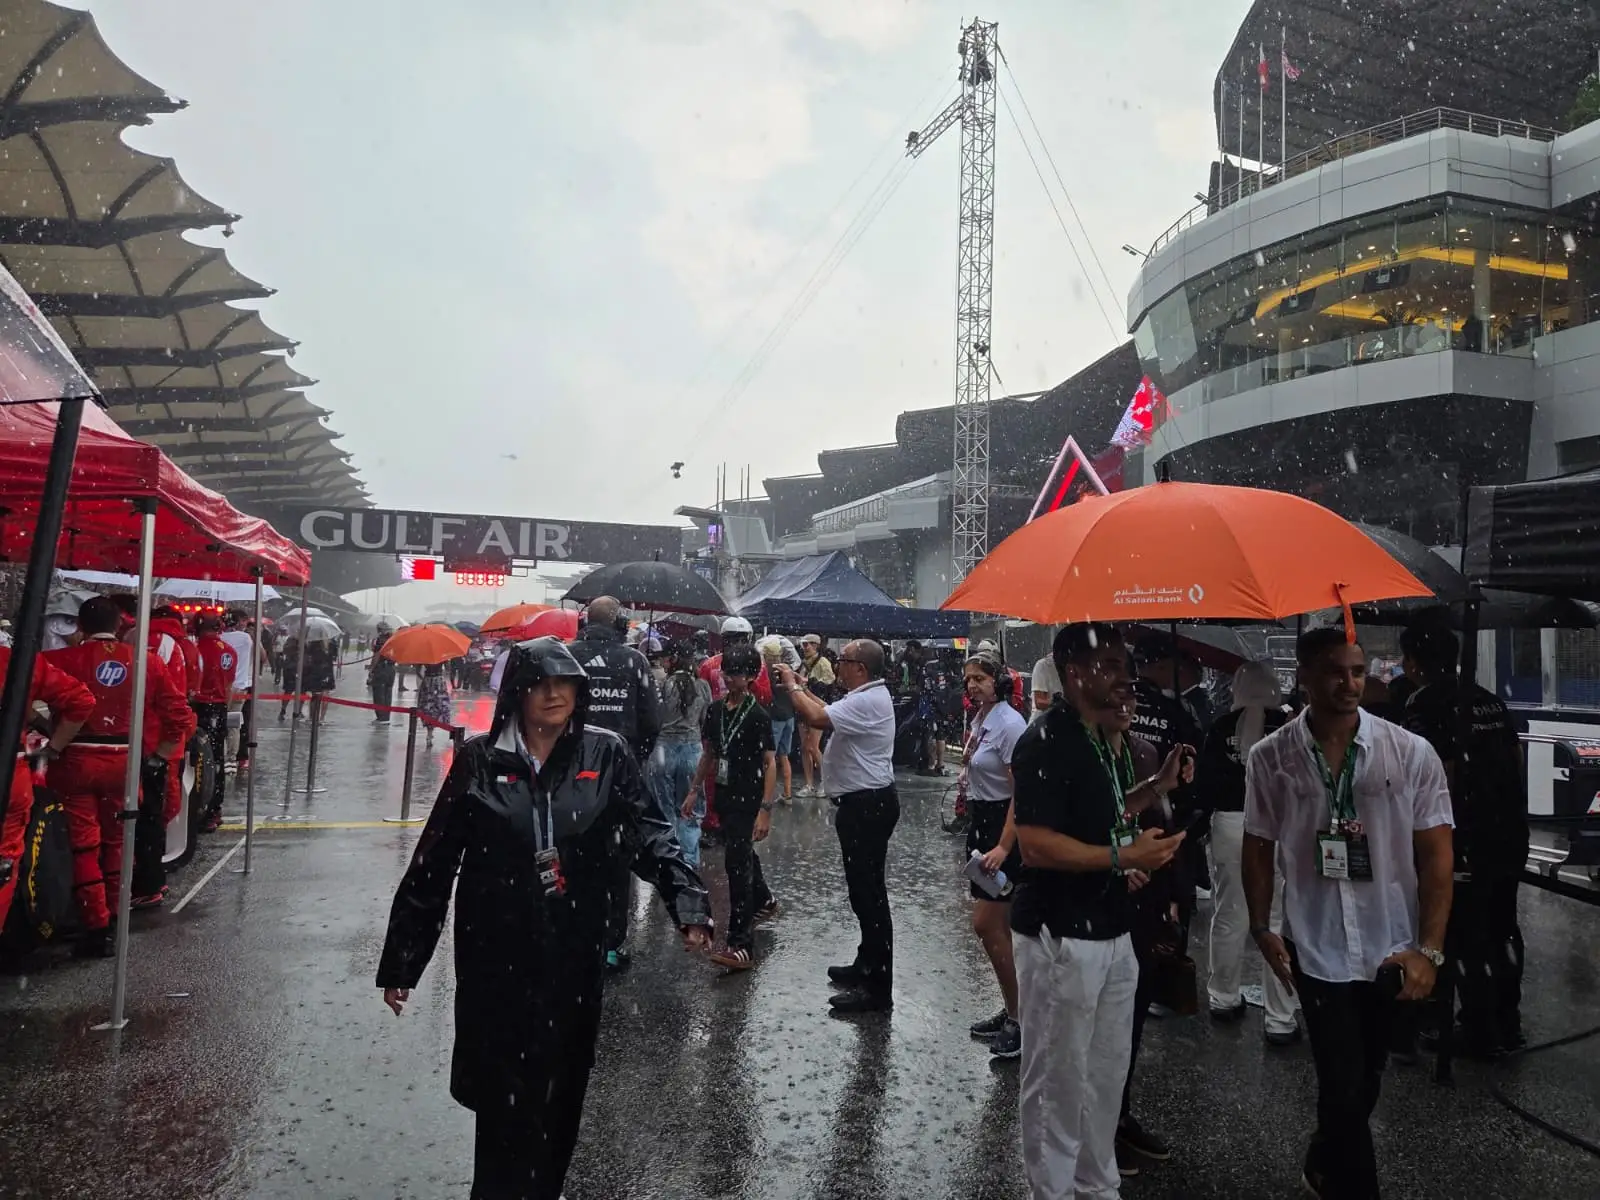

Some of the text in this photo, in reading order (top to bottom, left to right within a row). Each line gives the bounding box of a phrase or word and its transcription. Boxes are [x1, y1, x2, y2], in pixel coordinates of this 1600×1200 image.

[300, 510, 570, 559] GULF AIR
[1114, 595, 1183, 605] Al Salam Bank
[99, 661, 124, 687] hp
[589, 688, 628, 698] ONAS
